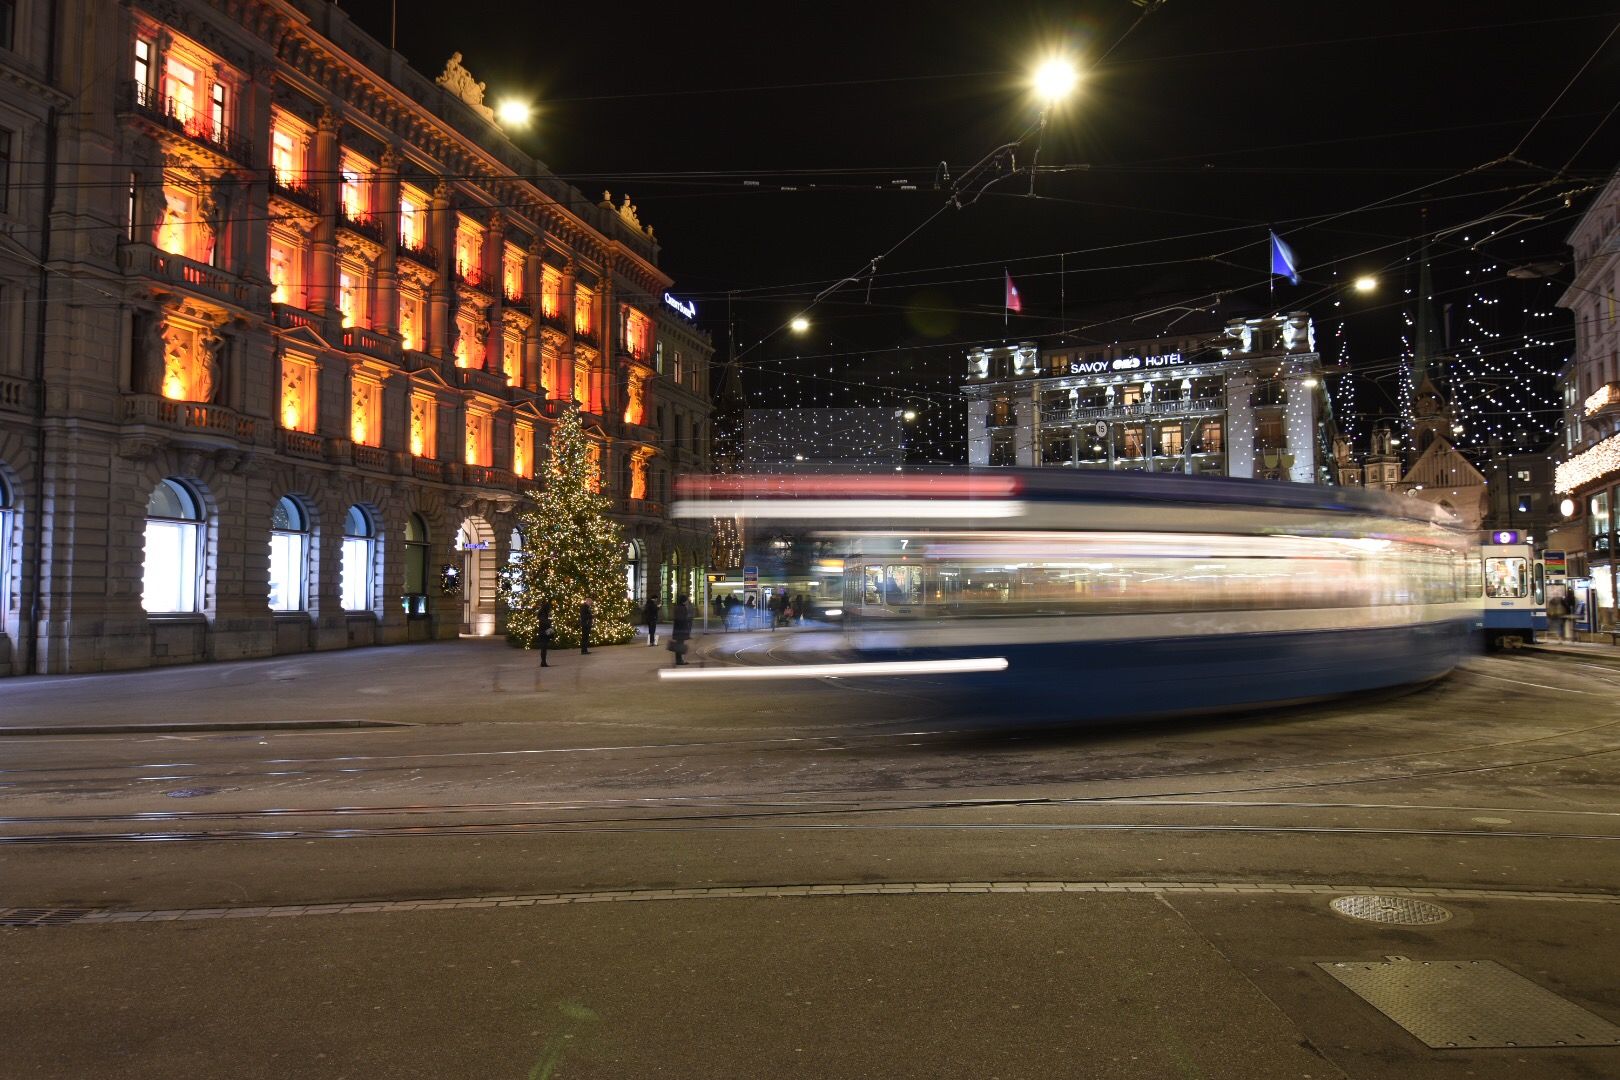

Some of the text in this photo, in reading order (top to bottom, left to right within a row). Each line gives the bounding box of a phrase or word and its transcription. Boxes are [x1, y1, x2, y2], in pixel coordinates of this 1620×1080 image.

[1070, 361, 1109, 374] SAVOY
[1145, 353, 1185, 367] HOTEL
[1098, 425, 1105, 433] 15
[900, 539, 909, 550] 7
